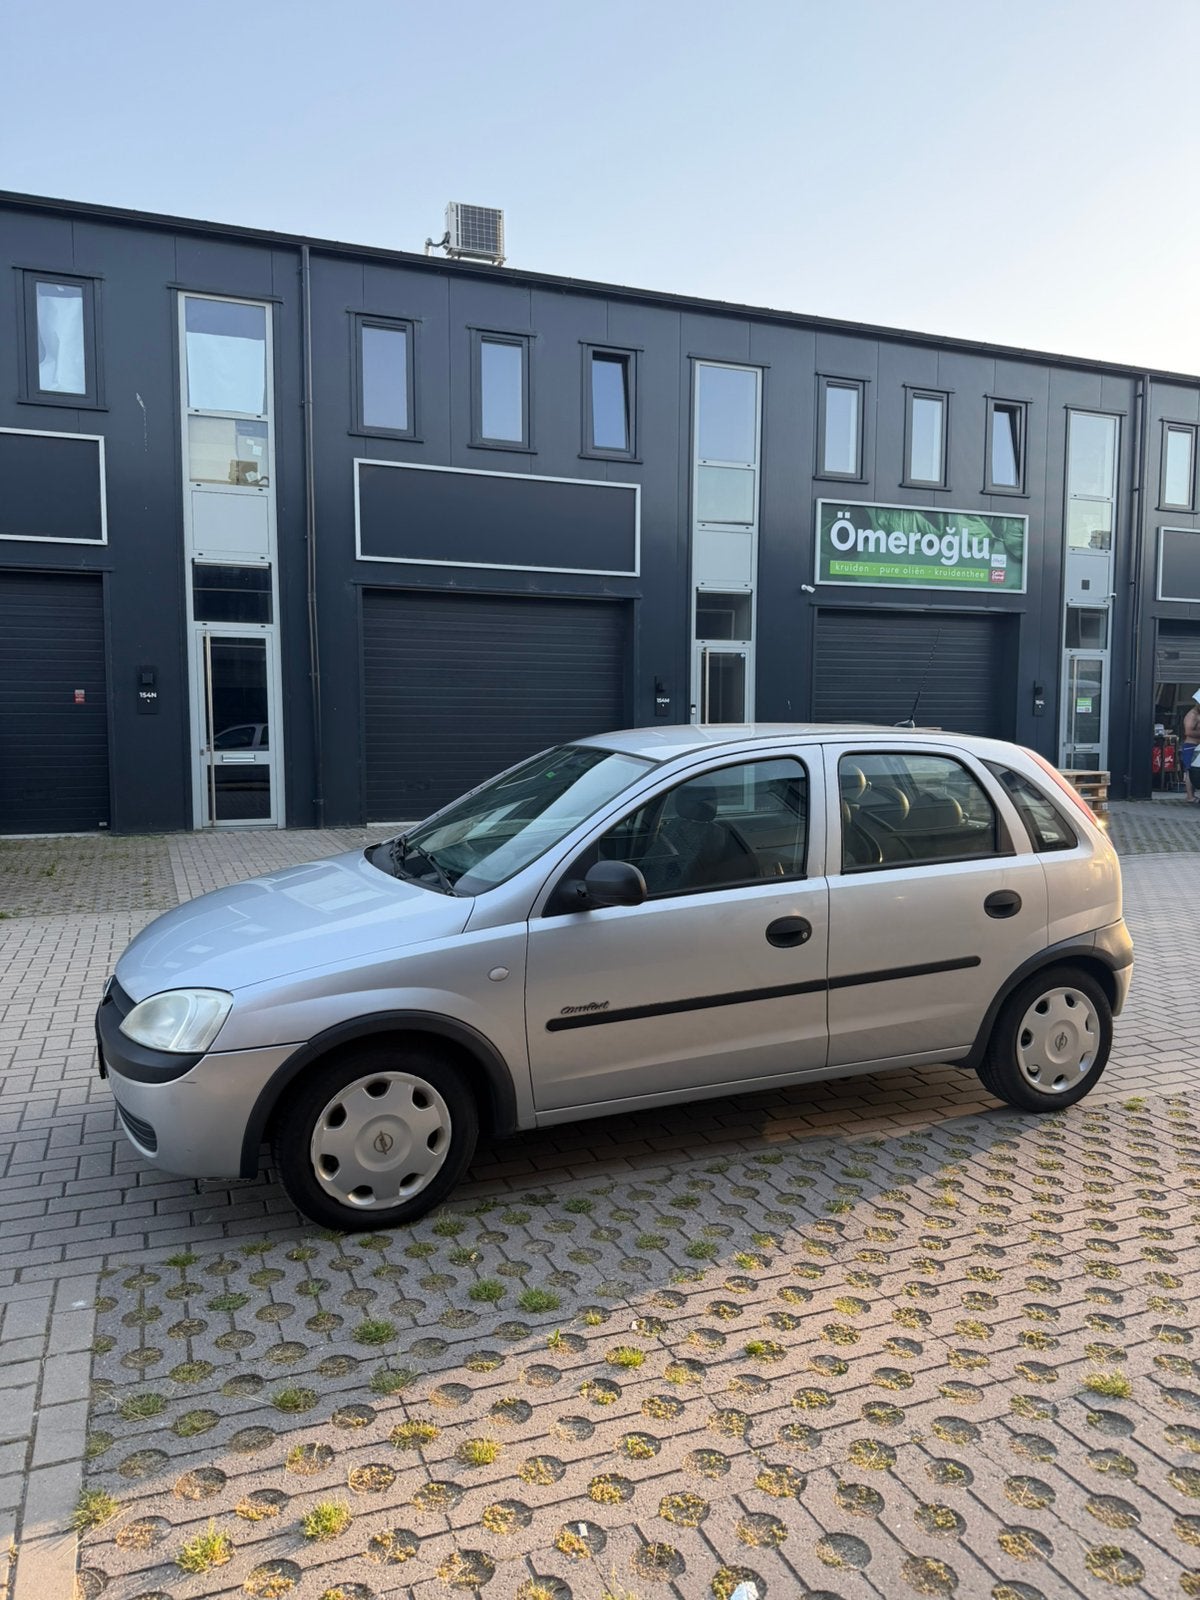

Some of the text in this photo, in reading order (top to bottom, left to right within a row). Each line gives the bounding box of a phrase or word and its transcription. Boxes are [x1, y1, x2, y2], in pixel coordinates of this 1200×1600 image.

[830, 511, 990, 566] Ömeroğlu
[835, 561, 869, 572] kruiden
[879, 566, 900, 577] pure
[934, 567, 985, 579] kruidenthee
